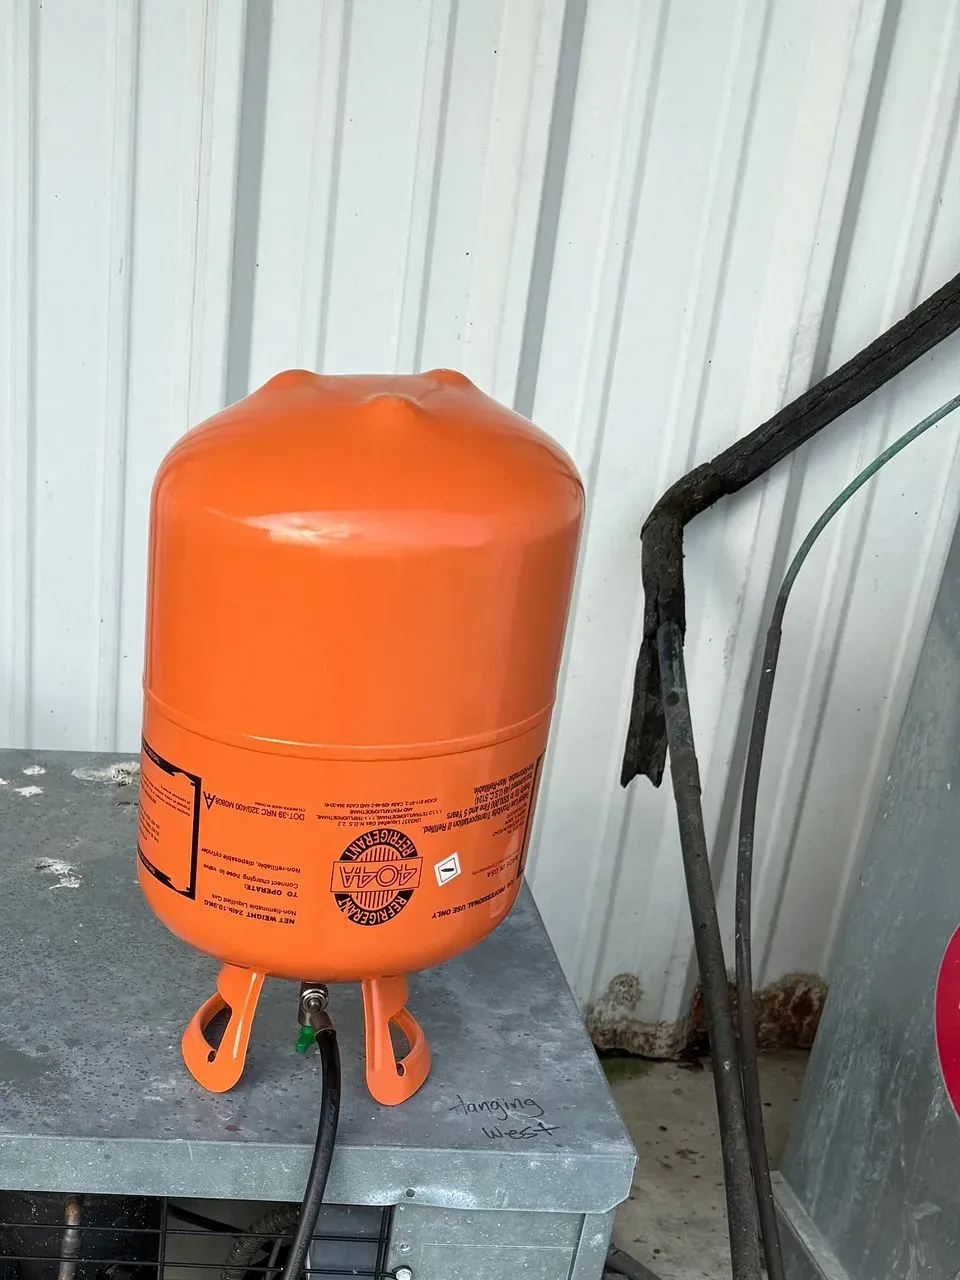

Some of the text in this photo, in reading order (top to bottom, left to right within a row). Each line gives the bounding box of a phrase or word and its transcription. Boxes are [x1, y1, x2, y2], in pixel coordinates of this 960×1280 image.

[235, 803, 260, 814] 320/400
[469, 806, 479, 814] and
[480, 800, 490, 810] Fine
[261, 808, 277, 817] NRC
[278, 811, 305, 820] DOT-39
[447, 810, 463, 819] Years
[453, 812, 490, 828] Transportation
[345, 830, 415, 860] REFRIGERANT
[201, 848, 222, 858] cylinder
[223, 854, 254, 867] disposable
[203, 863, 216, 872] valve
[226, 871, 240, 879] hose
[243, 874, 270, 884] charging
[339, 864, 417, 888] 404A
[271, 880, 298, 889] Connect
[244, 884, 282, 896] OPERATE:
[212, 894, 222, 902] Gas
[467, 886, 506, 908] PROFESSIONAL
[338, 896, 407, 924] REFRIGERANT
[432, 909, 451, 919] ONLY
[453, 904, 466, 914] USE
[246, 912, 276, 922] WEIGHT
[481, 1121, 561, 1140] West
